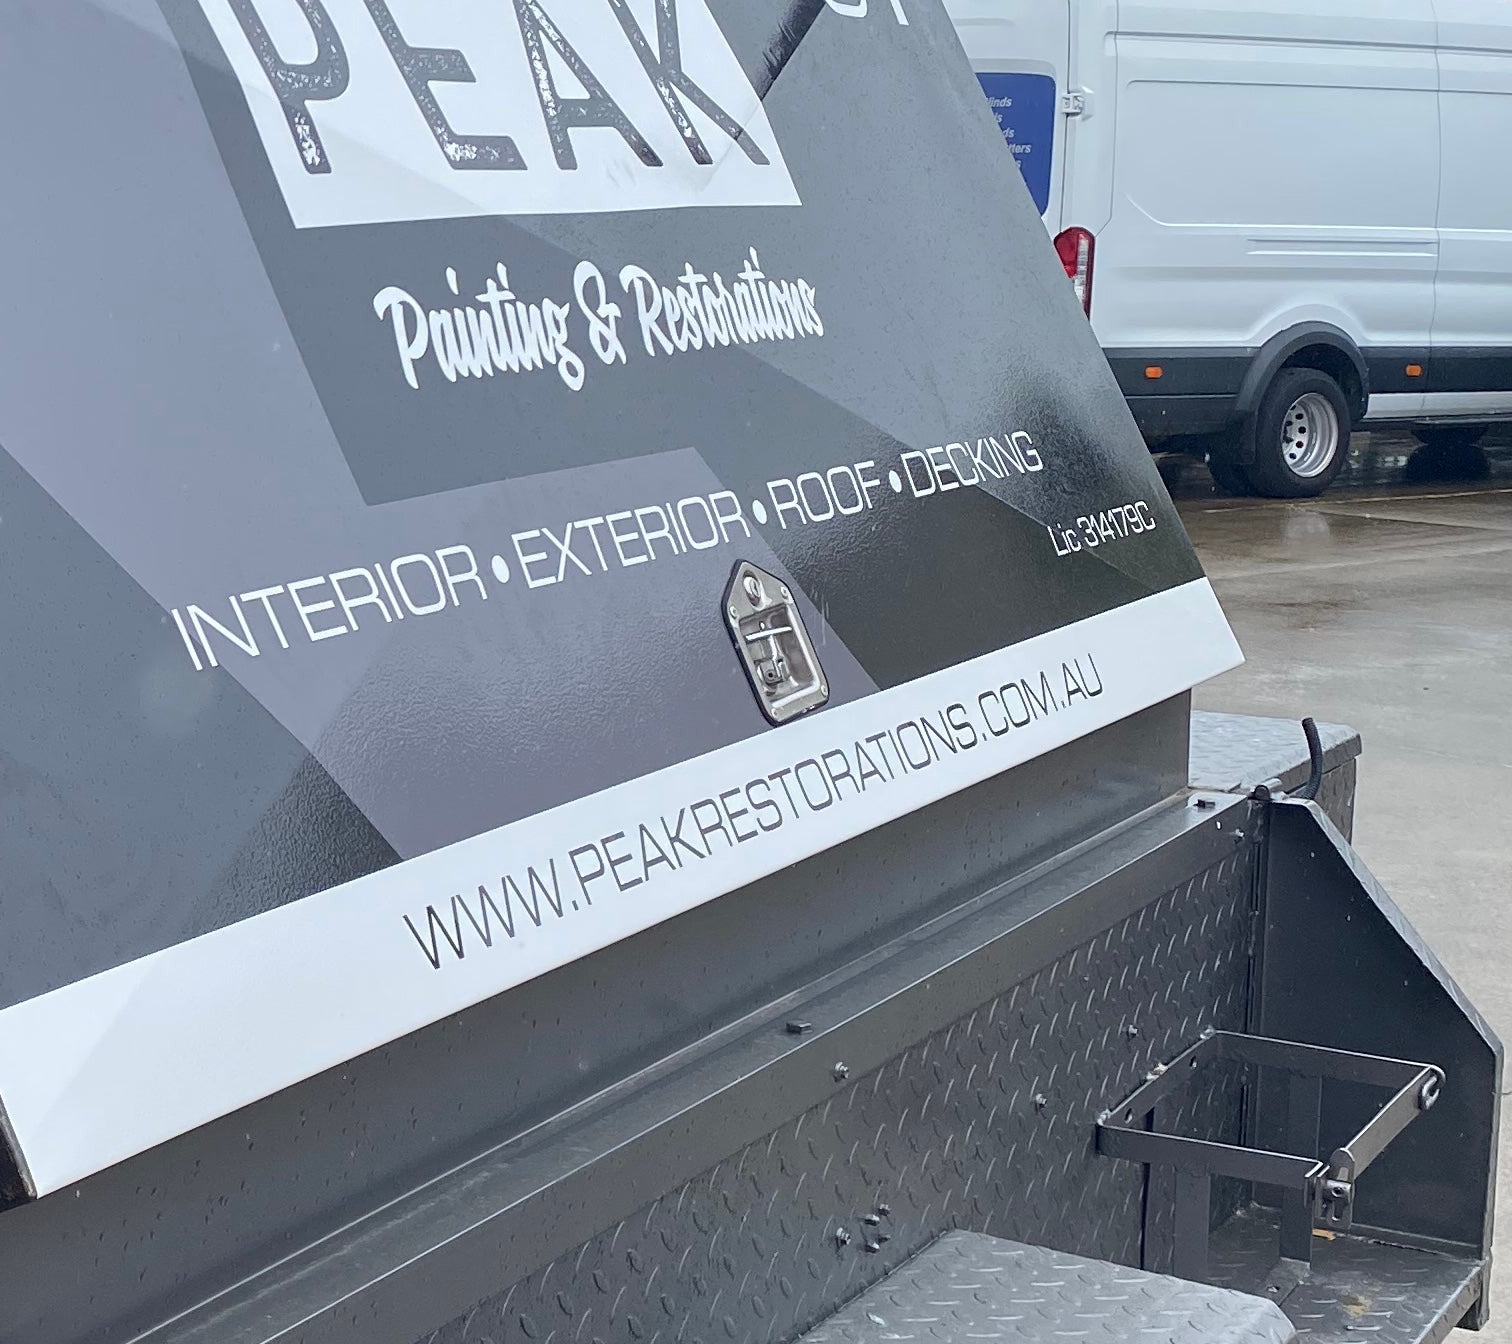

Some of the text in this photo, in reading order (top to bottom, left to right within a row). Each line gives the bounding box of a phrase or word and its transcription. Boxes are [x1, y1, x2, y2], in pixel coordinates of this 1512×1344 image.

[372, 246, 825, 391] Painting & Restorations
[171, 430, 1044, 671] INTERIOR EXTERIOR ROOF DECKING
[1048, 500, 1158, 557] Lic 314179C
[402, 653, 1105, 971] WWW.PEAKRESTORATIONS.COM.AU
